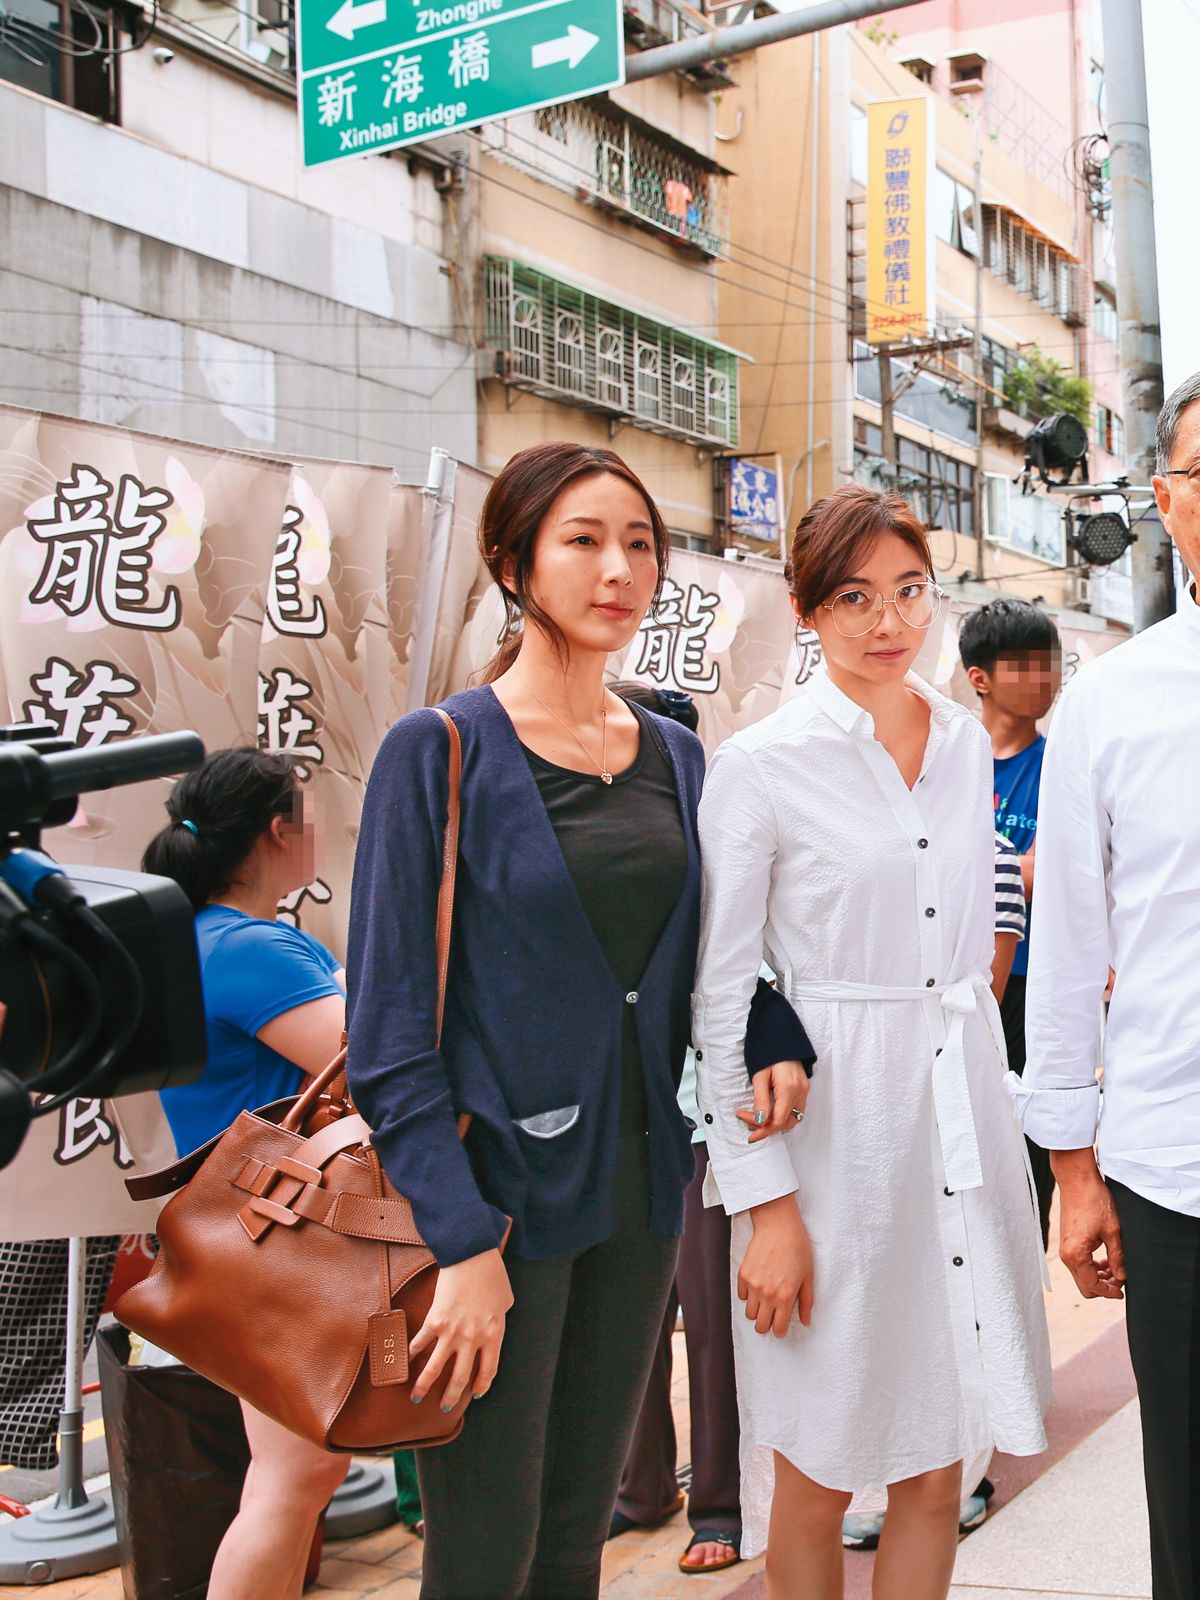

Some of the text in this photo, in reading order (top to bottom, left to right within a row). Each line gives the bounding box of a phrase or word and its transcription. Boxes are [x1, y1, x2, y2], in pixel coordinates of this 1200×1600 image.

[317, 31, 491, 127] 新海橋
[340, 101, 468, 151] Xinhai Bridge
[635, 578, 720, 694] 龍
[383, 1333, 395, 1364] S.S.
